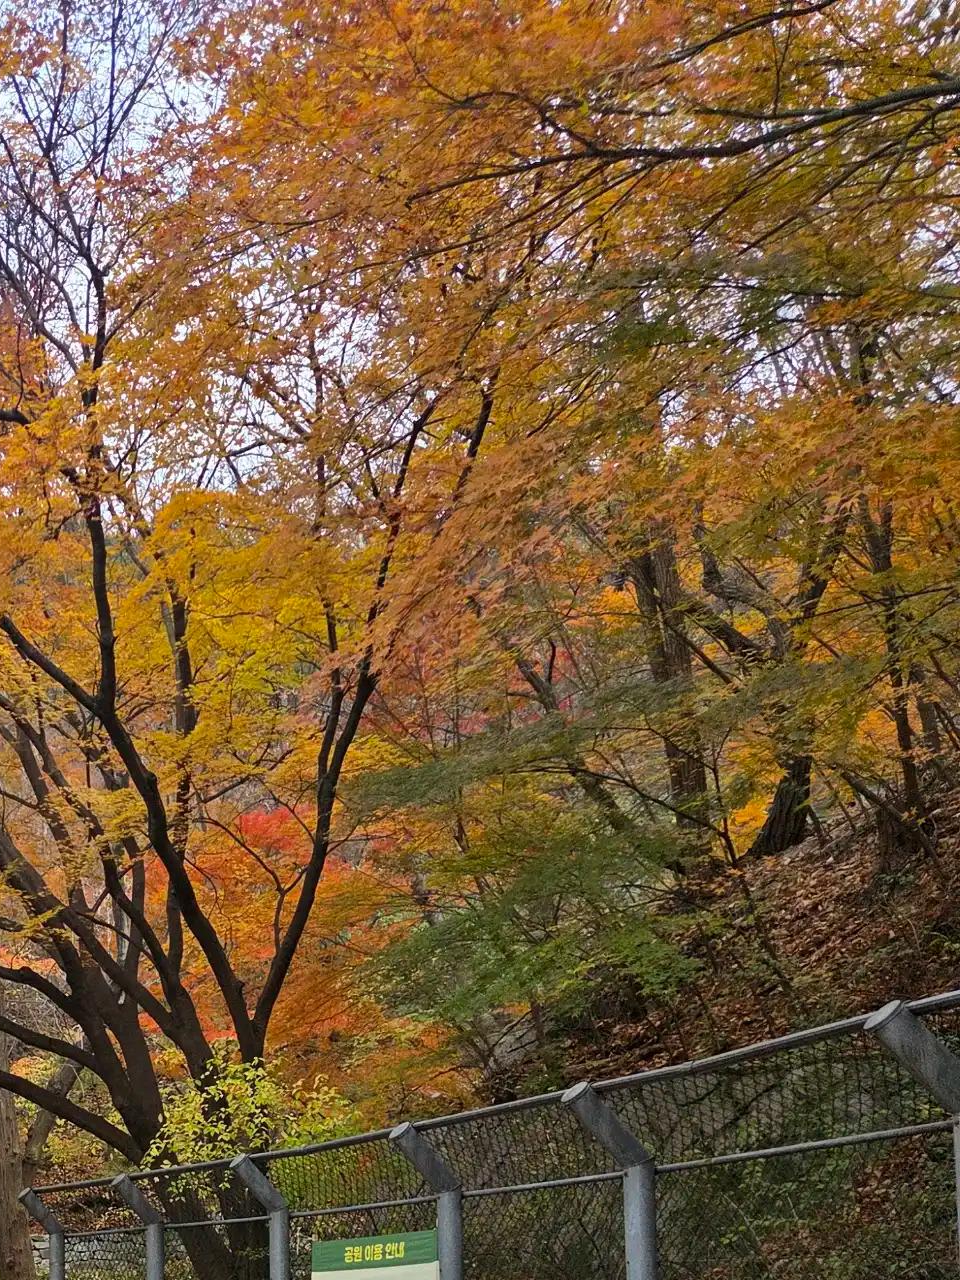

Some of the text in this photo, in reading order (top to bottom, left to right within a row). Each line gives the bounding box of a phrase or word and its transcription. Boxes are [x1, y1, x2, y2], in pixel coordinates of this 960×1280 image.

[343, 1241, 405, 1263] 공원 이용 안내
